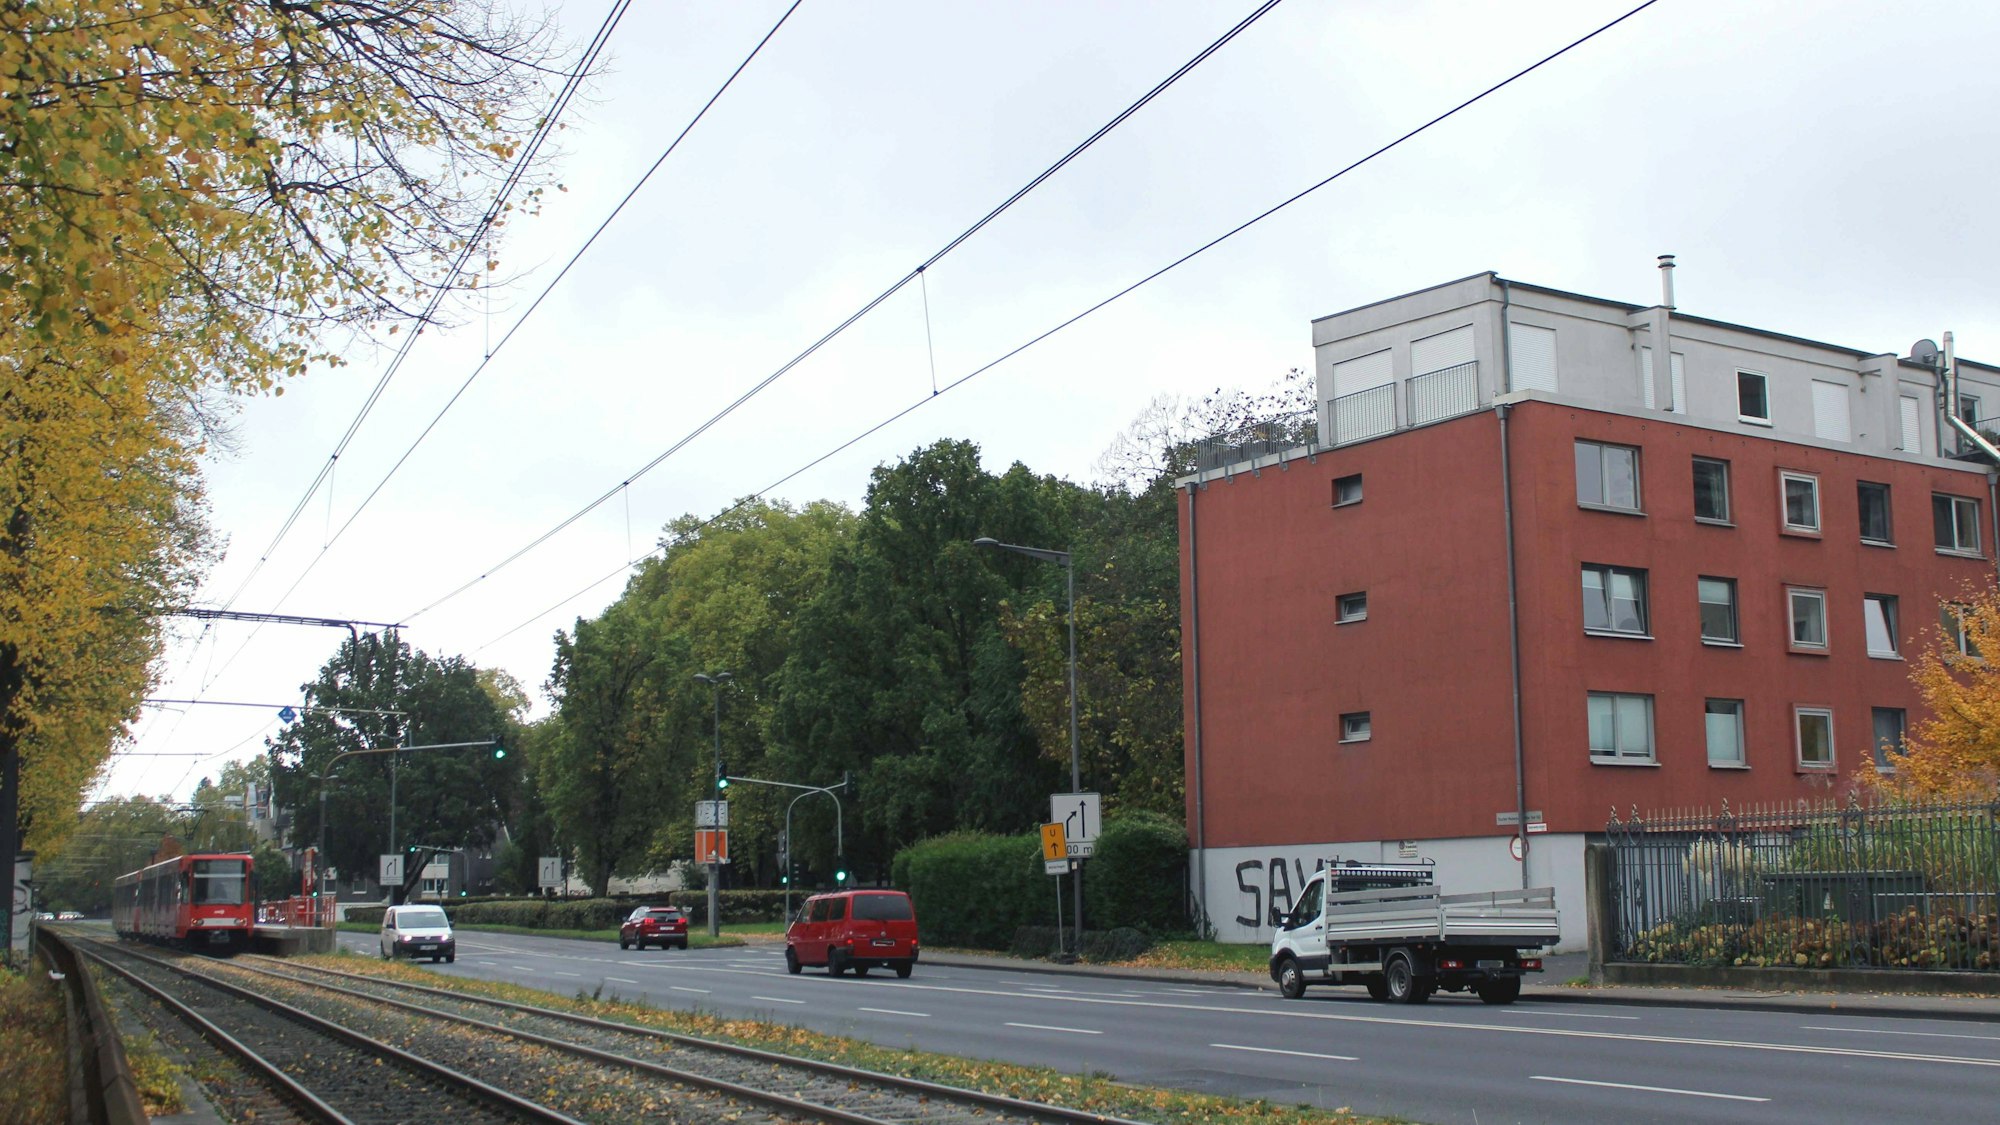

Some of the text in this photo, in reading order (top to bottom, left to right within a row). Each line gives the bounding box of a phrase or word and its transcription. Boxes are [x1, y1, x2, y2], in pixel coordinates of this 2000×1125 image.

[1050, 829, 1056, 837] U
[1066, 845, 1092, 854] 00 m
